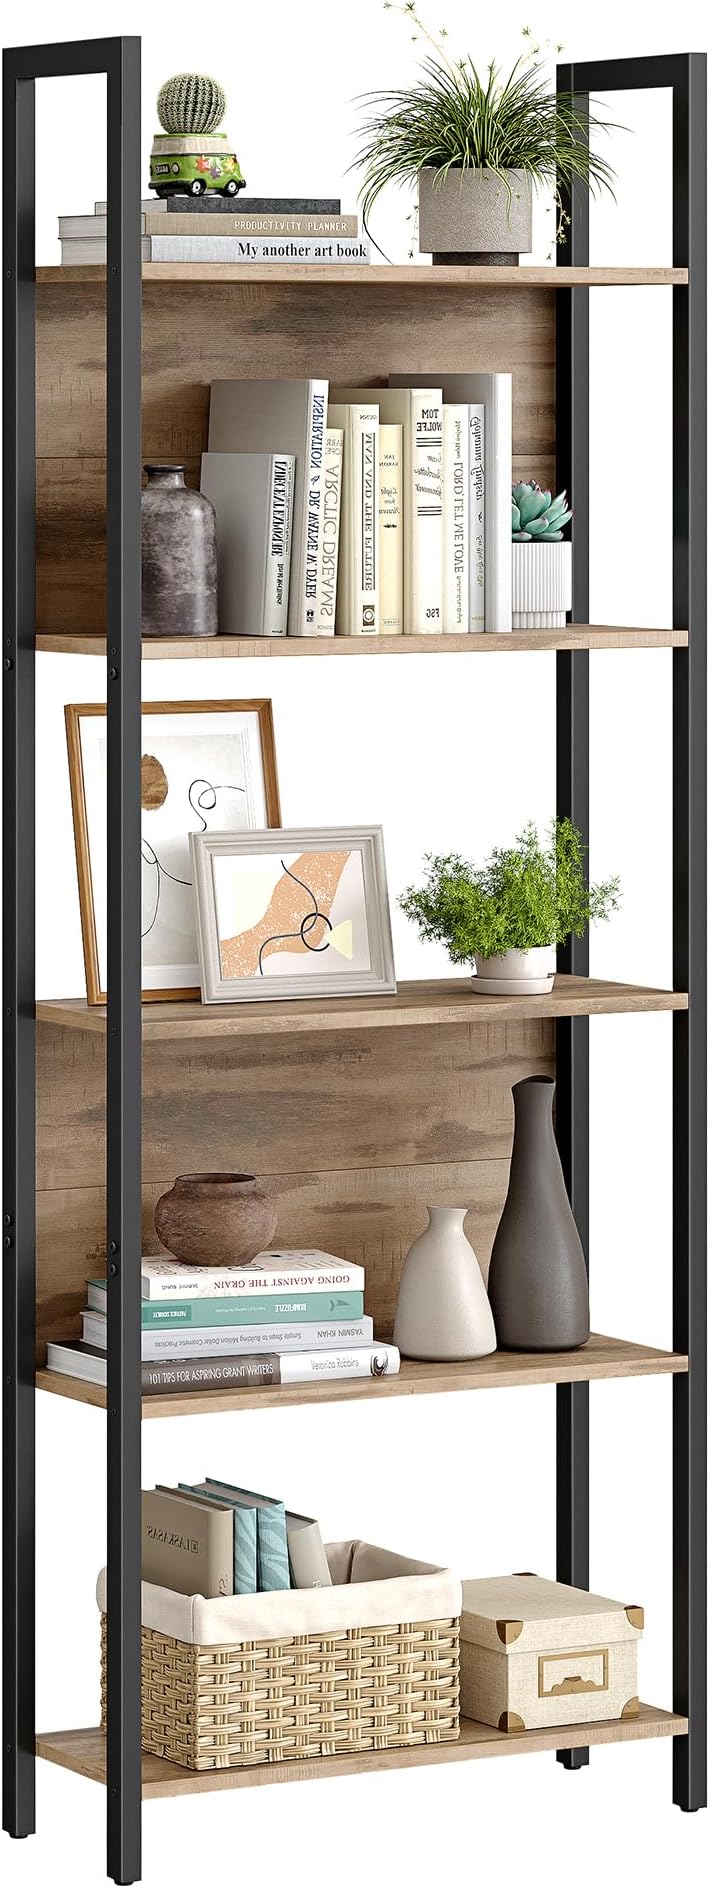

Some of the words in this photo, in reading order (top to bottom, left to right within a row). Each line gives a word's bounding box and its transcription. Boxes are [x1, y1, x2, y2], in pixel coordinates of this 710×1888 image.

[234, 221, 302, 231] PRODUCTIVITY
[307, 222, 348, 231] PLANNER
[238, 242, 259, 259] My
[262, 243, 311, 257] another
[314, 244, 333, 257] art
[337, 243, 367, 257] book
[249, 1279, 268, 1287] THE
[271, 1277, 314, 1286] AGAINST
[318, 1275, 350, 1284] GOING
[214, 1280, 246, 1289] GRAIN
[284, 1331, 302, 1340] Simple
[317, 1330, 336, 1339] KHAN
[338, 1328, 364, 1337] YASMIN
[179, 1338, 203, 1347] Cosmetic
[204, 1337, 220, 1346] Dollar
[221, 1336, 239, 1345] Million
[239, 1334, 261, 1343] Building
[154, 1339, 178, 1348] Practices
[311, 1359, 336, 1371] Veronica
[337, 1358, 359, 1369] Robbins
[149, 1373, 161, 1385] 101
[162, 1372, 176, 1383] TIPS
[177, 1371, 190, 1382] FOR
[191, 1367, 221, 1381] ASPIRING
[221, 1366, 246, 1379] GRANT
[247, 1363, 274, 1376] WRITERS
